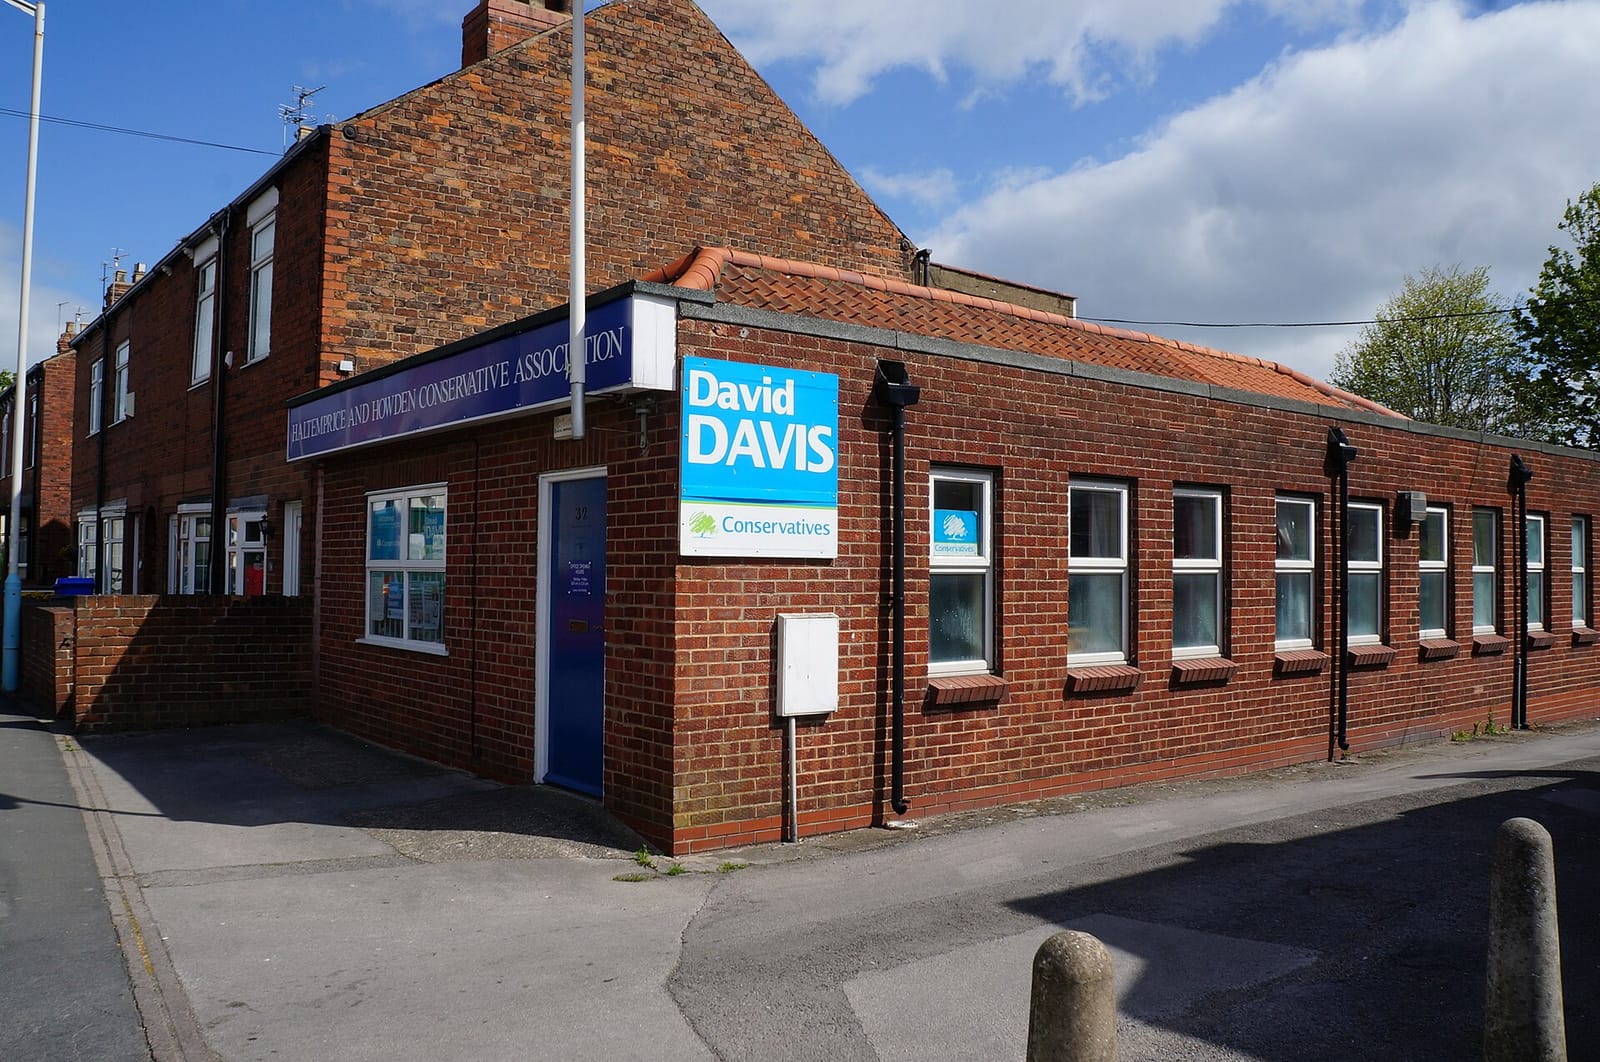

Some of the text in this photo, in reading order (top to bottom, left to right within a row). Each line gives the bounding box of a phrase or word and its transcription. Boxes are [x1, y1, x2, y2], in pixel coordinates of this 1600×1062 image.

[291, 326, 625, 442] HALTEMPRICE AND HOWDEN CONSERVATIVE ASSOCITION
[689, 369, 795, 416] David
[688, 414, 835, 473] DAVIS
[575, 506, 588, 520] 32
[722, 516, 831, 536] Conservatives
[934, 544, 975, 552] Conservatives
